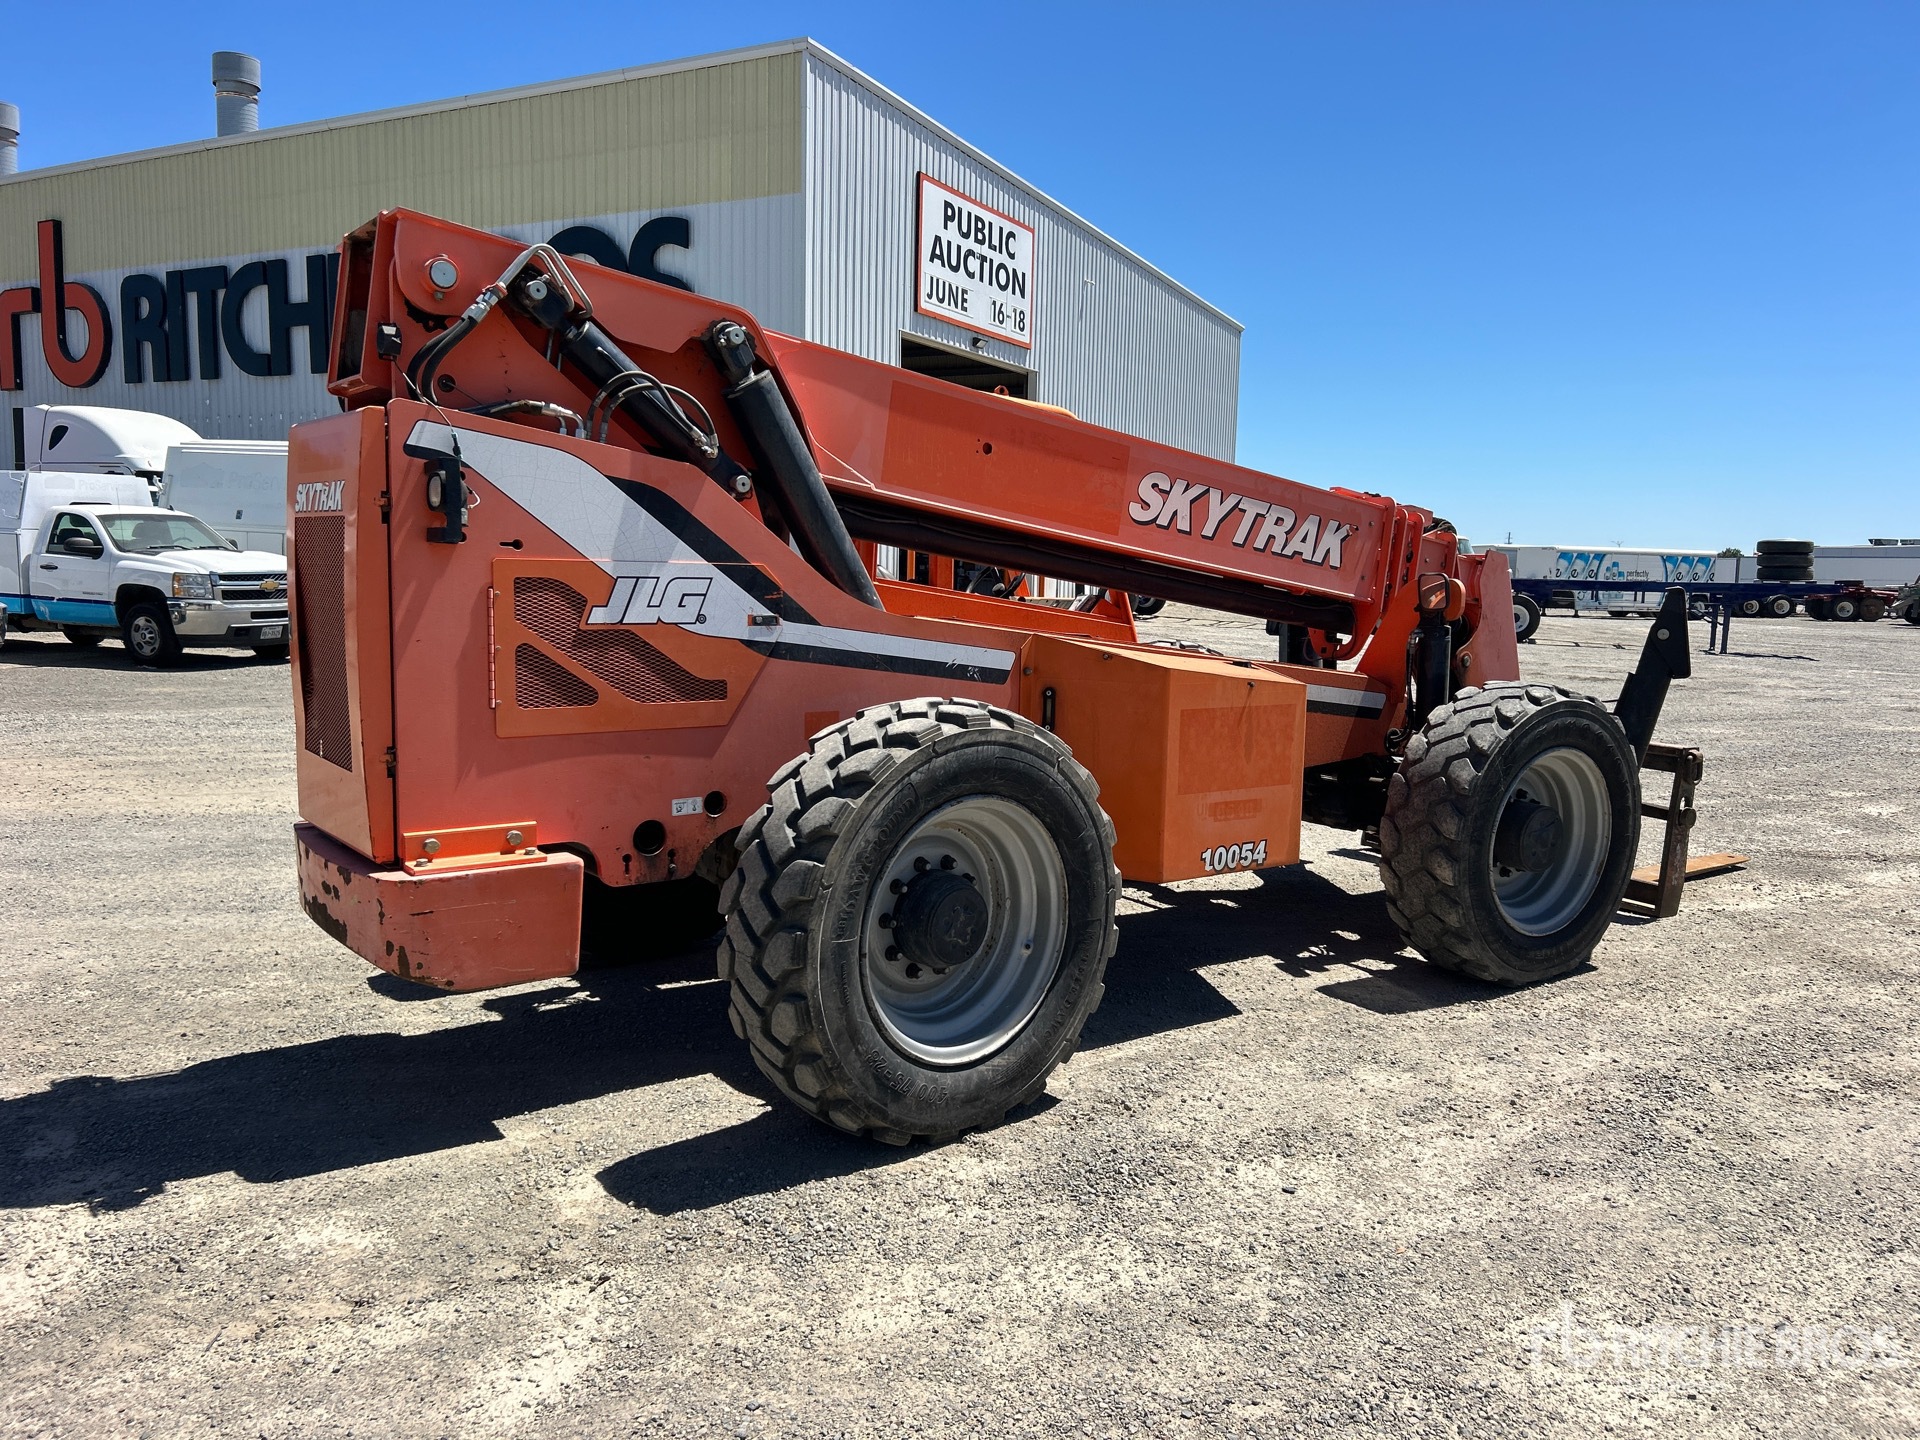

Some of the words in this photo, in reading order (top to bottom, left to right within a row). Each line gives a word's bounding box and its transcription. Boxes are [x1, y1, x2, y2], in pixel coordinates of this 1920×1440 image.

[943, 199, 1017, 261] PUBLIC
[928, 234, 1027, 300] AUCTION
[120, 253, 341, 384] RITCH
[926, 276, 970, 313] JUNE
[991, 299, 1026, 333] 16-18
[294, 479, 346, 513] SKYTRAK
[1128, 471, 1357, 569] SKYTRAK
[1201, 838, 1268, 873] 10054
